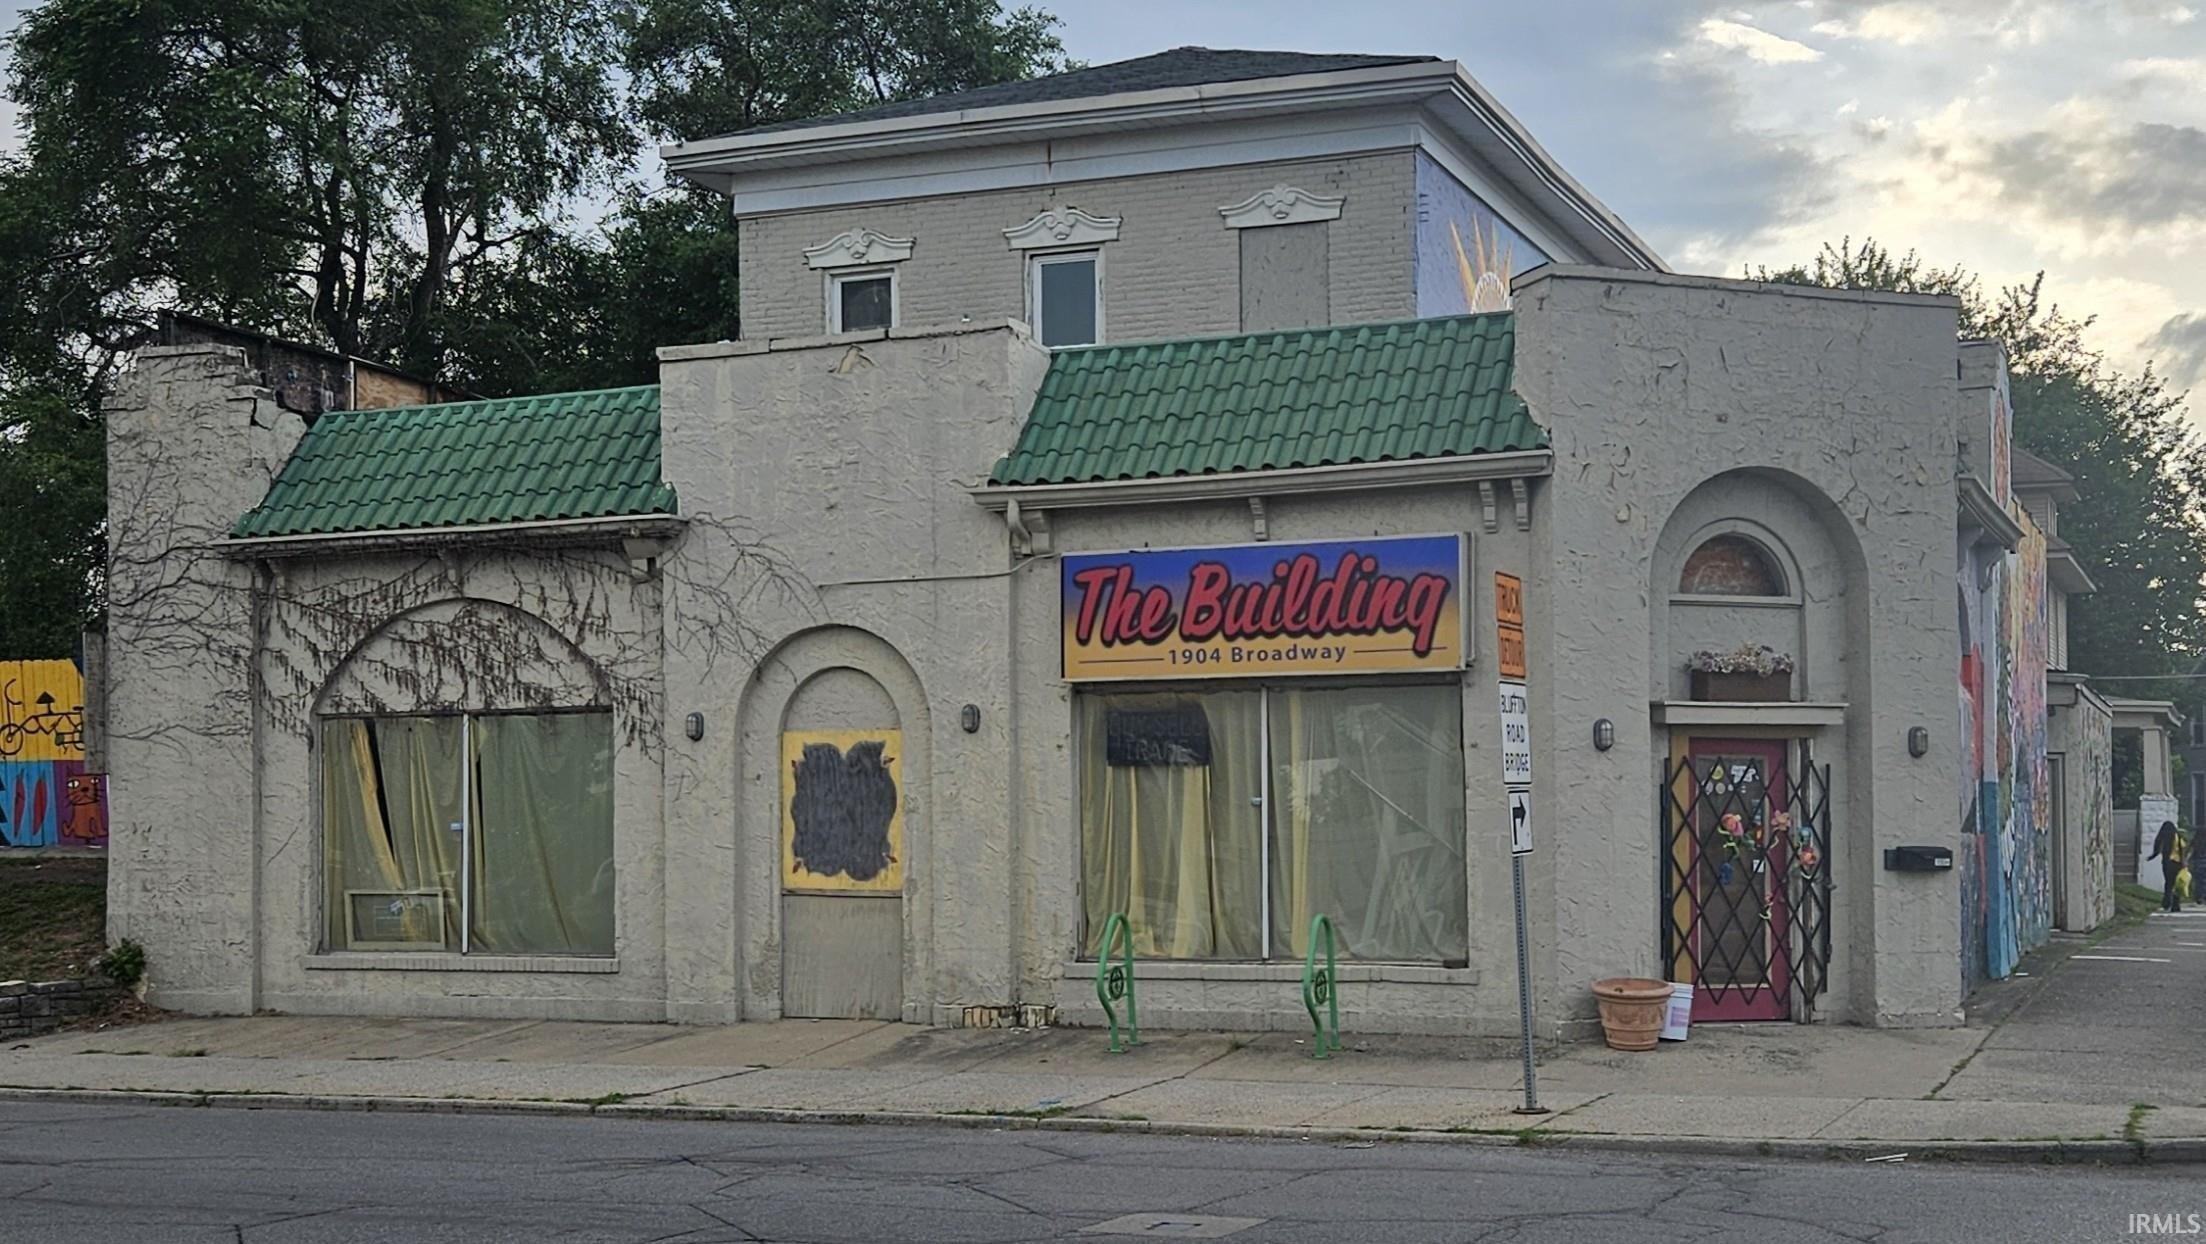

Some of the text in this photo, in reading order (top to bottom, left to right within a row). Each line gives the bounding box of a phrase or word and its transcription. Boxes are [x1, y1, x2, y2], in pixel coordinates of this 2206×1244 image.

[1073, 552, 1450, 657] The Building
[1168, 643, 1347, 664] 1904 Broadway
[1506, 723, 1525, 742] ROAD
[1504, 752, 1529, 772] BRIDGE
